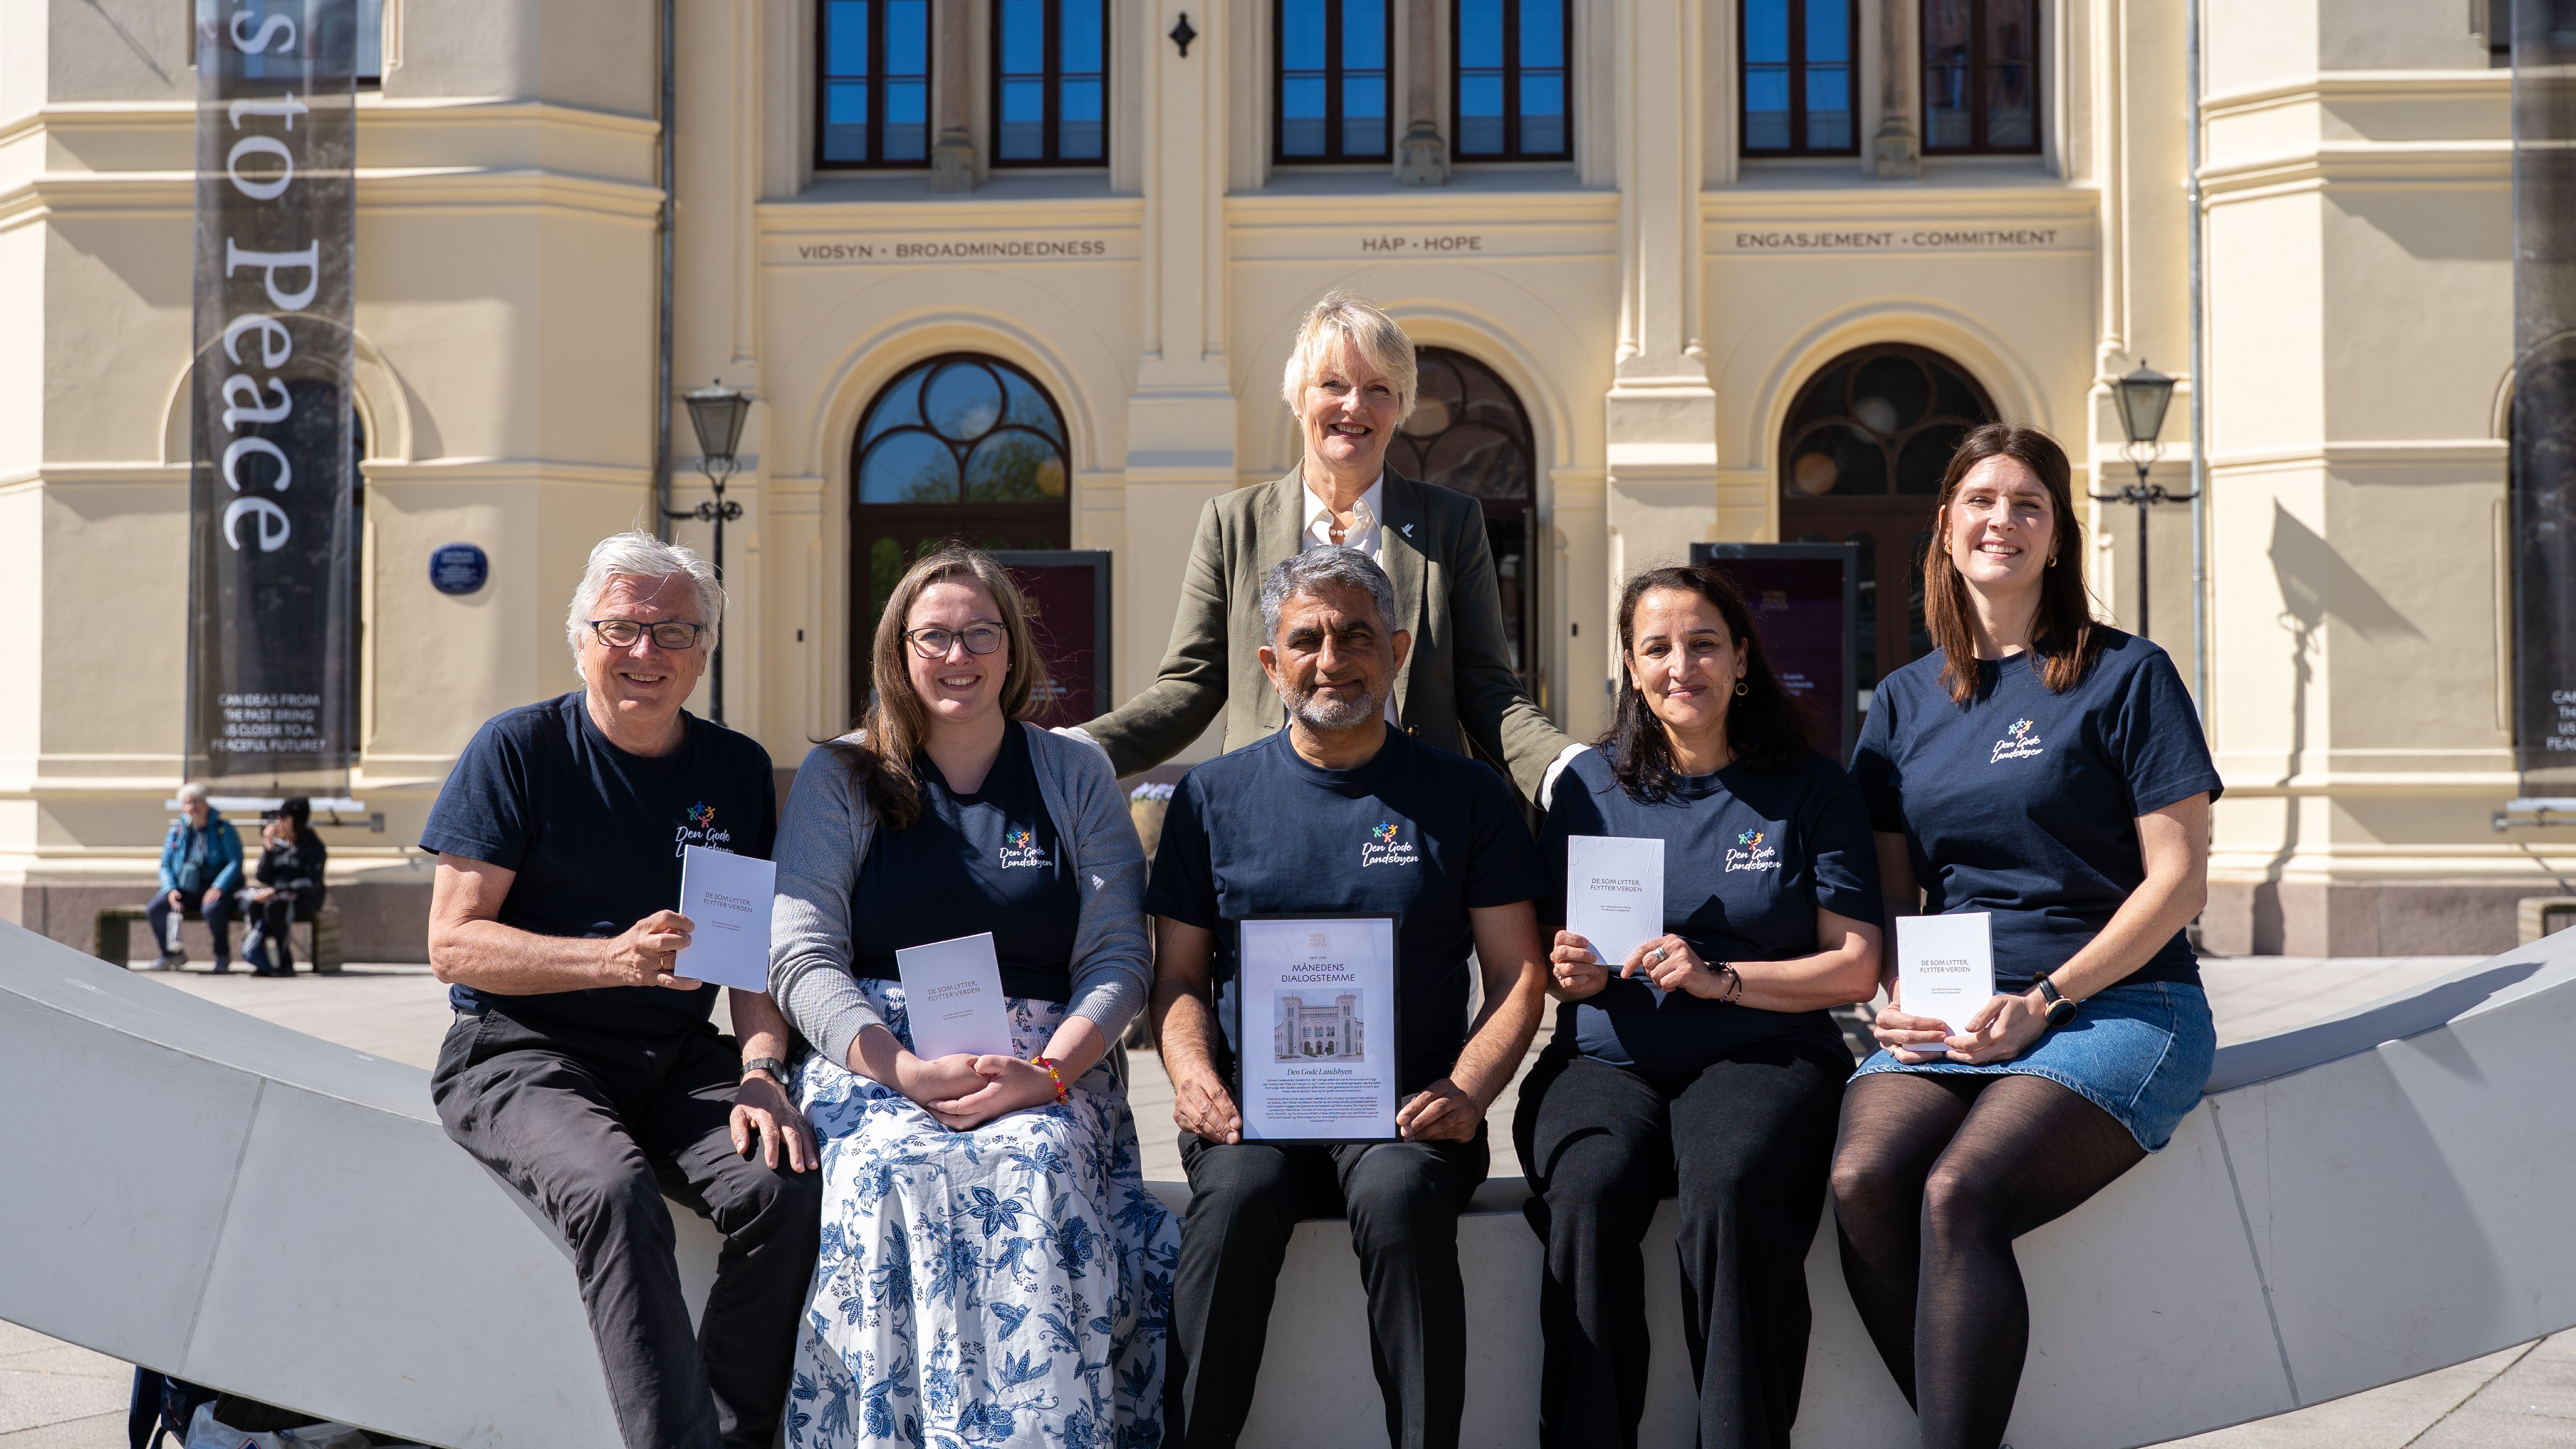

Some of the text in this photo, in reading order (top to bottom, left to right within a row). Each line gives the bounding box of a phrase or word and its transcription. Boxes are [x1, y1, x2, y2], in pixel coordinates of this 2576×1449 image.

[1362, 234, 1482, 251] HÅP HOPE
[1736, 229, 2058, 248] ENGASJEMENT COMMITMENT
[799, 241, 1106, 258] VIDSYN BROADMINDEDNESS
[222, 0, 319, 552] s to Peace
[217, 693, 243, 707] CAN
[279, 693, 321, 707] FROM
[243, 708, 272, 722] PAST
[273, 708, 315, 722] BRING
[237, 723, 283, 737] CLOSER
[283, 723, 303, 737] TO
[303, 724, 316, 737] A
[1993, 735, 2041, 752] Den Gode
[1990, 747, 2044, 764] Landsbyen
[675, 826, 730, 843] Den Gode
[999, 846, 1045, 858] Den Gode
[1362, 841, 1413, 855] Den Gode
[1725, 846, 1775, 861] Den Gode
[1002, 857, 1053, 869] Landsbyen
[1363, 853, 1419, 867] Landsbyen
[1725, 860, 1782, 872] Landsbyen
[704, 898, 753, 913] FLYTTER VERDEN
[1292, 963, 1344, 972] MÅNEDENS
[1282, 974, 1355, 982] DIALOGSTEMME
[928, 987, 981, 1002] FLYTTER VERDEN
[1319, 1068, 1352, 1076] Landsbyen
